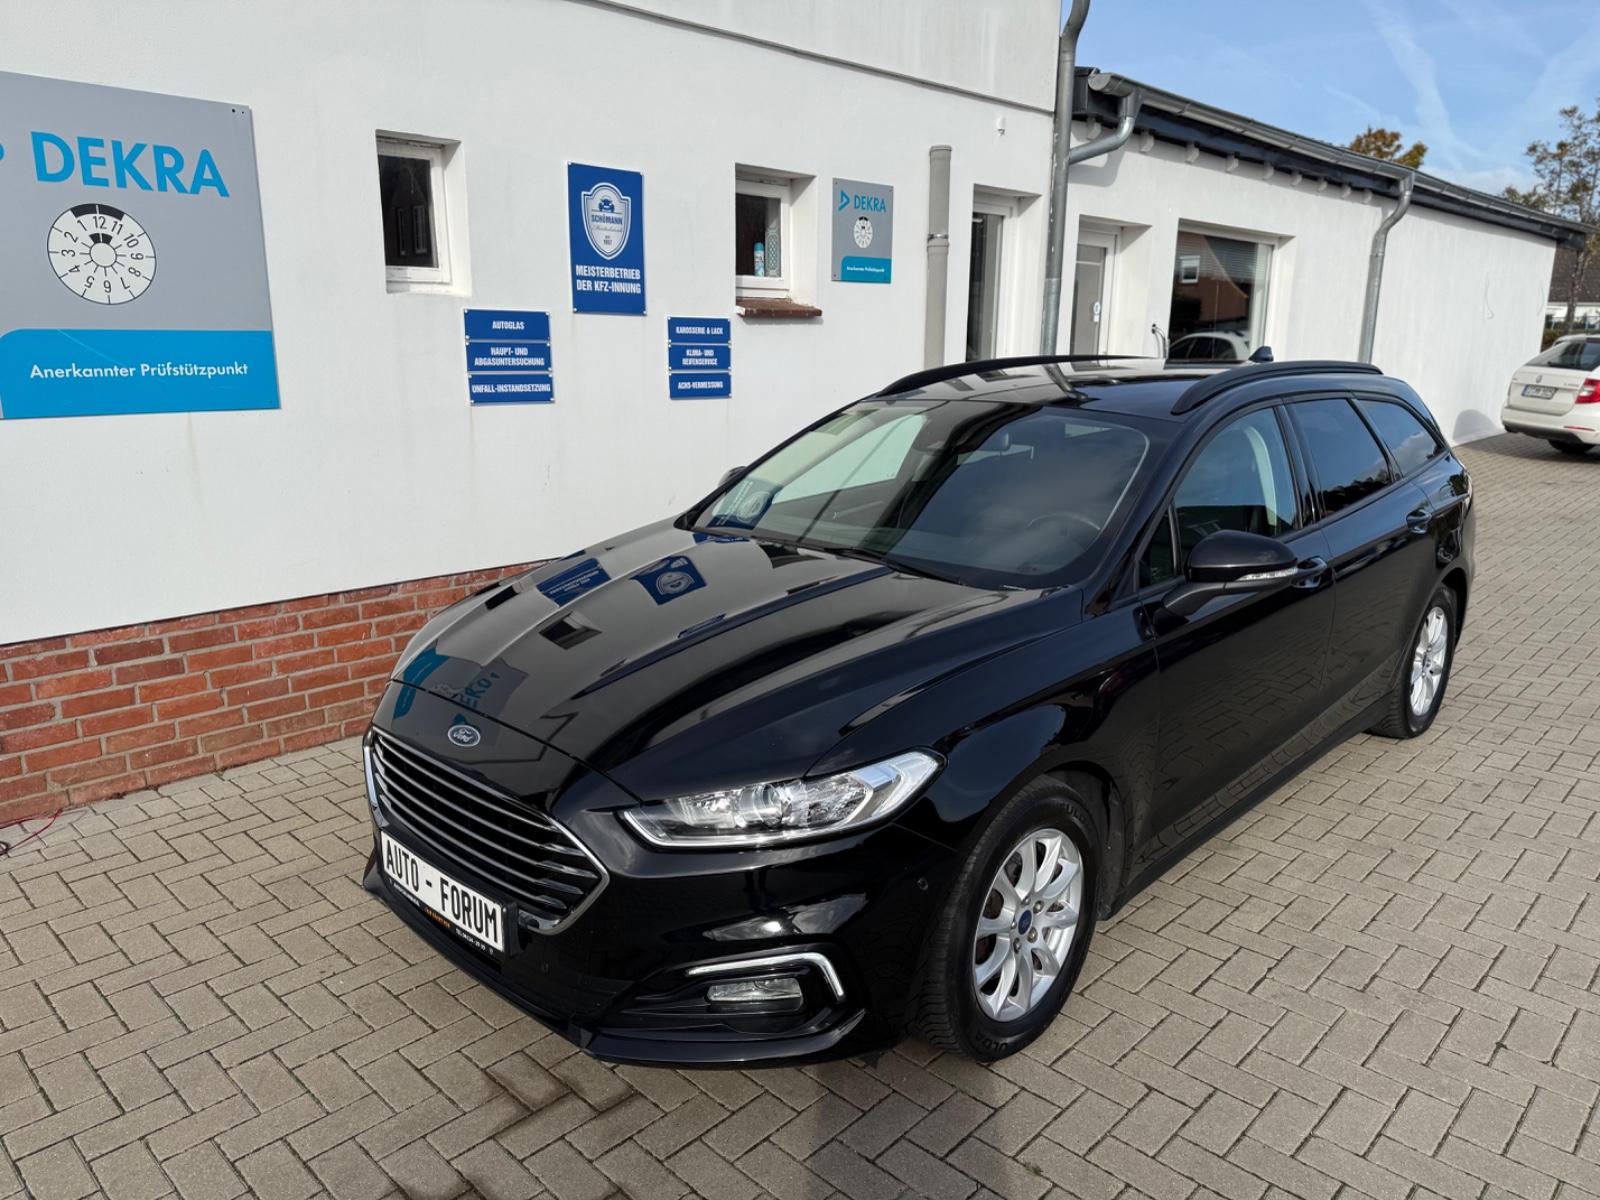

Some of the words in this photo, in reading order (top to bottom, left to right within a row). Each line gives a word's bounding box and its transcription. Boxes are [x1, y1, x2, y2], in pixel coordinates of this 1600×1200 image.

[30, 131, 230, 197] DEKRA
[854, 194, 886, 212] DEKRA
[76, 220, 87, 232] 1
[92, 215, 107, 230] 12
[112, 220, 123, 236] 11
[63, 231, 79, 243] 2
[123, 233, 140, 249] 10
[61, 249, 76, 258] 3
[130, 252, 144, 261] 9
[68, 264, 80, 273] 4
[128, 266, 141, 278] 8
[576, 264, 640, 280] MEISTERBETRIEB
[84, 275, 95, 289] 5
[103, 280, 112, 293] 6
[120, 276, 130, 290] 7
[577, 280, 592, 291] DER
[594, 280, 641, 294] KFZ-INNUNG
[492, 320, 525, 330] AUTOGLAS
[490, 347, 514, 355] HAUPT-
[515, 347, 528, 355] UND
[474, 357, 545, 366] ABGASUNTERSUCHUNG
[30, 363, 136, 379] Anerkannter
[141, 361, 249, 381] Prüfstützpunkt
[472, 384, 550, 393] UNFALL-INSTANDSETZUNG
[386, 840, 419, 892] AUTO
[426, 880, 432, 888] -
[440, 877, 498, 943] FORUM
